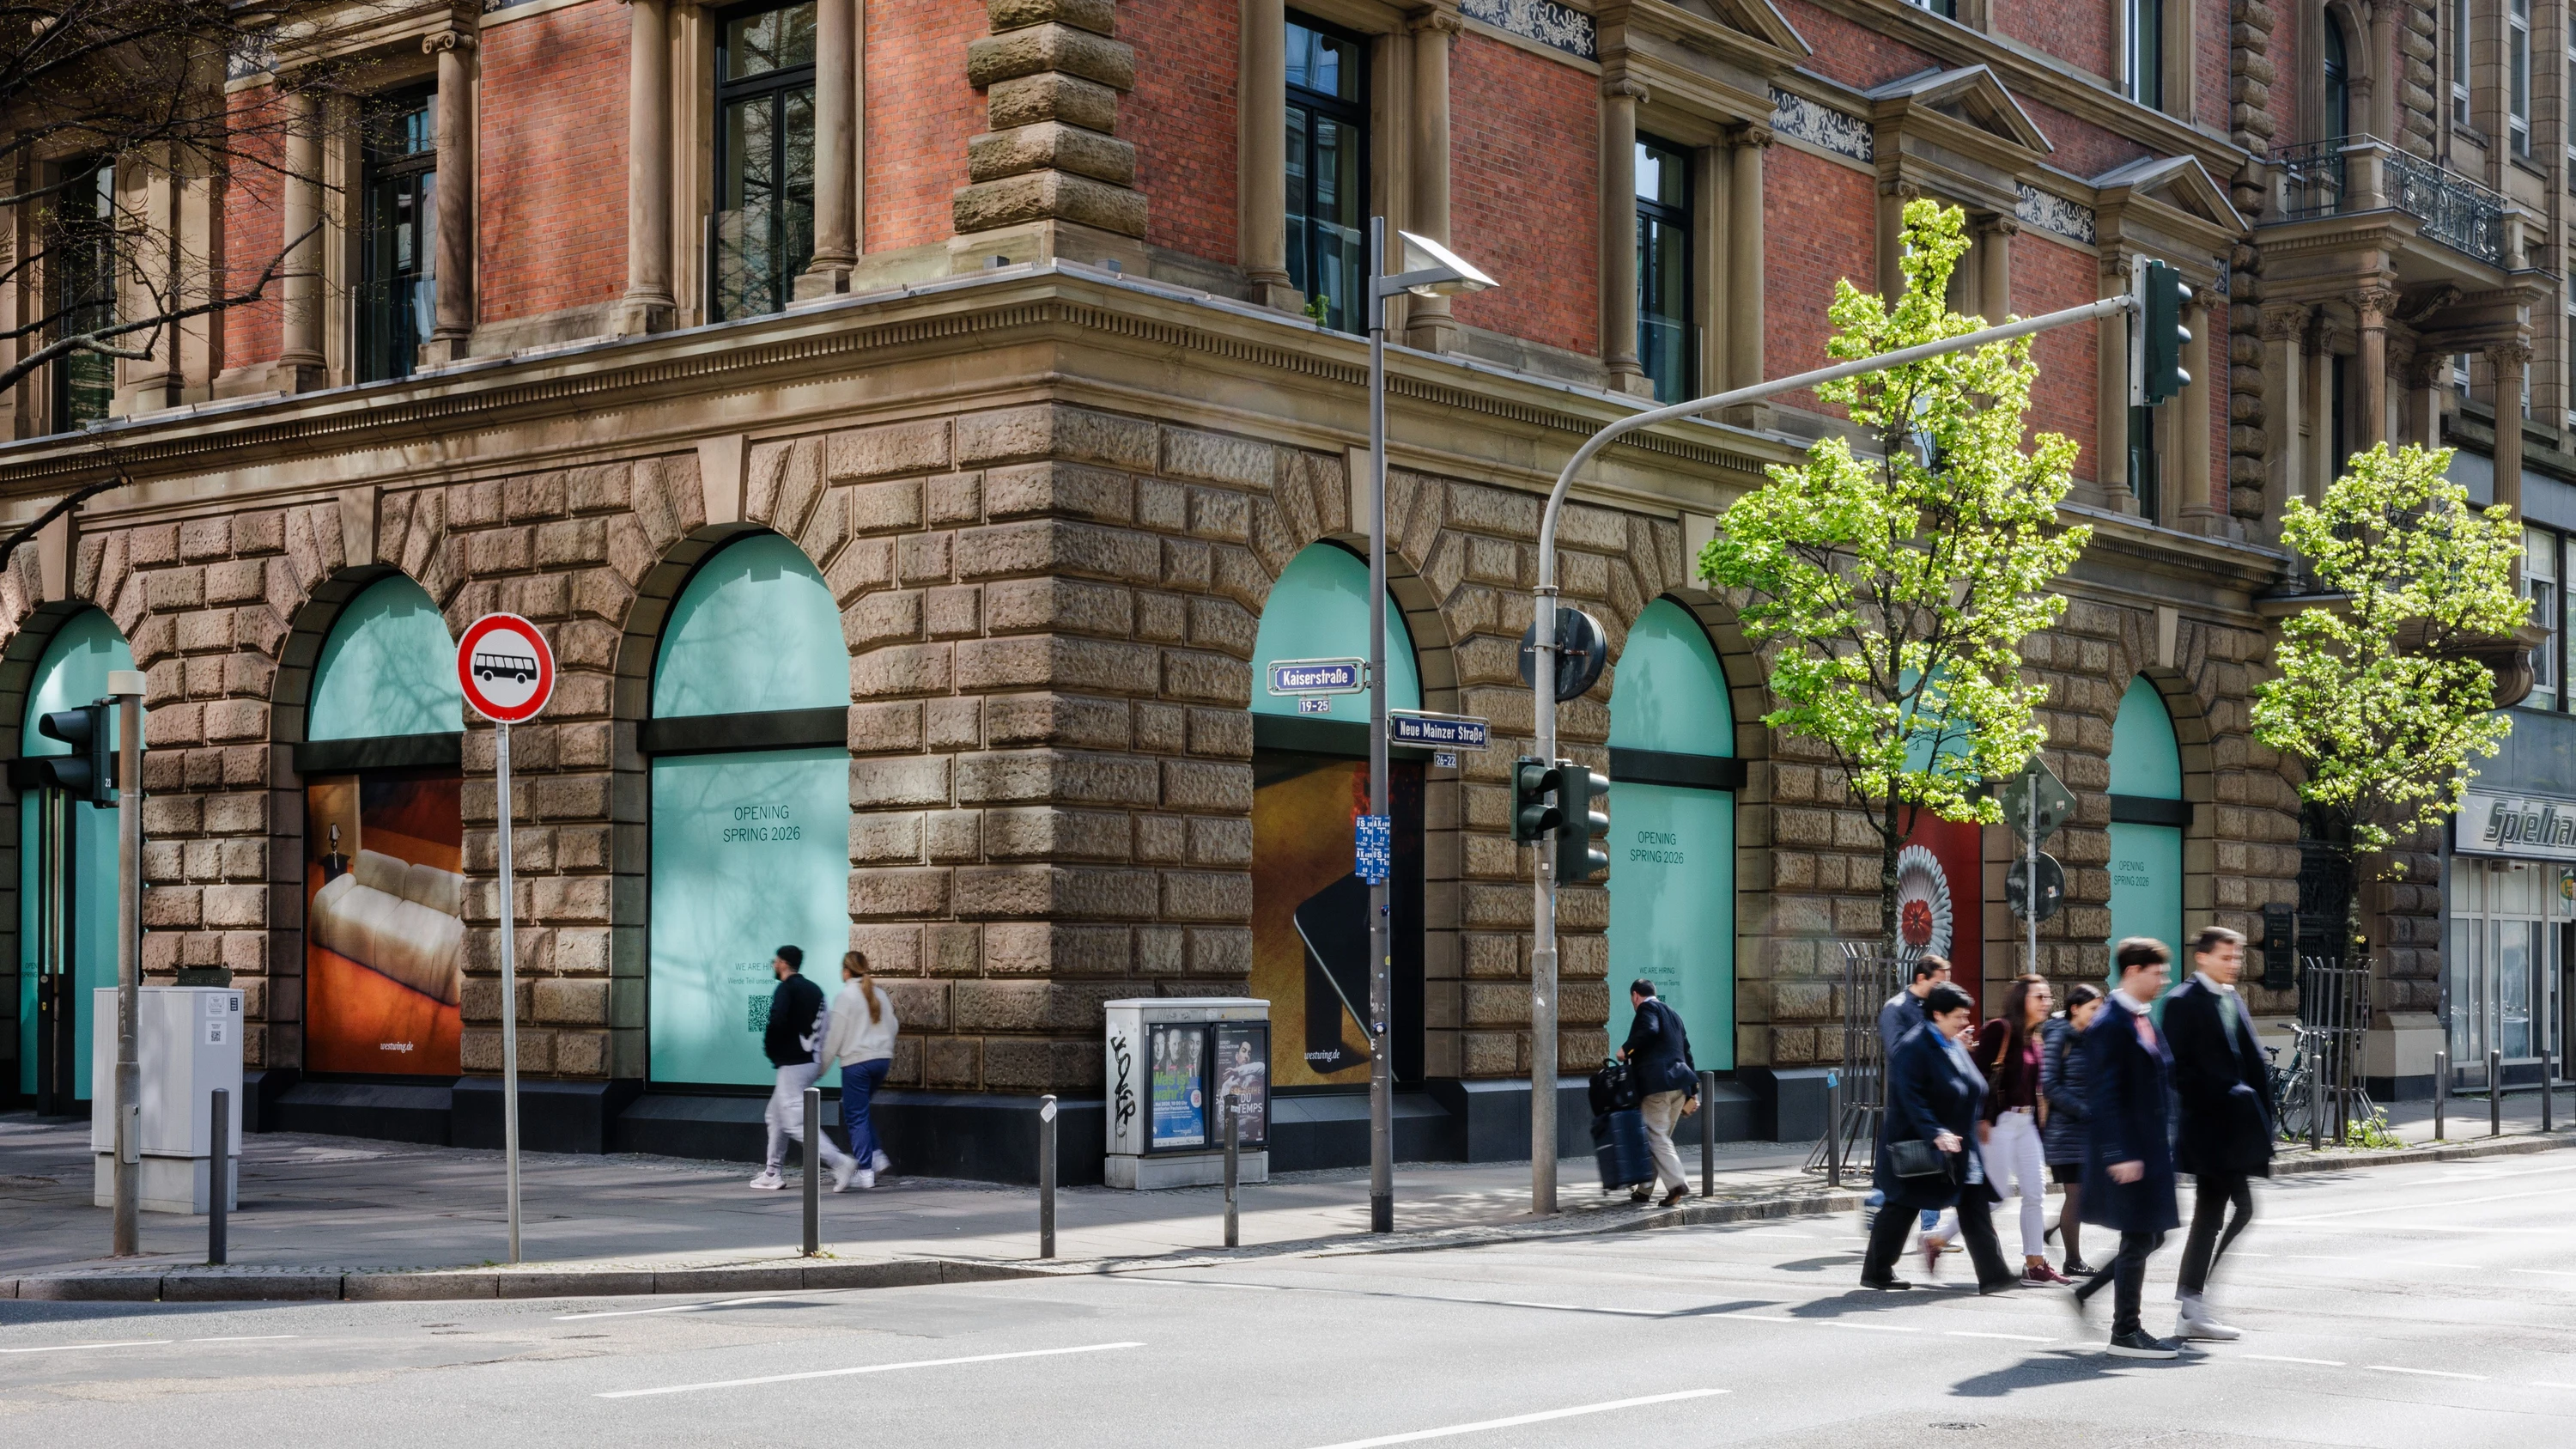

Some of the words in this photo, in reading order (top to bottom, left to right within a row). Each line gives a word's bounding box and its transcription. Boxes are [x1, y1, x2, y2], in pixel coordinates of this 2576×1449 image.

[1283, 668, 1348, 686] Kaiserstraße
[1301, 700, 1328, 712] 19-25
[1400, 721, 1420, 736] Neue
[1423, 722, 1455, 740] Mainzer
[1458, 726, 1483, 743] Straße
[734, 805, 790, 821] OPENING
[723, 827, 768, 843] SPRING
[771, 825, 800, 841] 2026
[1637, 831, 1676, 845] OPENING
[1630, 849, 1662, 863] SPRING
[1663, 850, 1684, 864] 2026
[2118, 860, 2144, 872] OPENING
[2113, 875, 2135, 886] SPRING
[2136, 876, 2150, 887] 2026
[380, 1040, 414, 1054] westwing.de
[1303, 1048, 1340, 1062] westwing.de
[1153, 1071, 1176, 1086] Was
[1177, 1071, 1190, 1086] ist
[1153, 1085, 1186, 1100] wahr?
[1241, 1093, 1252, 1104] DU
